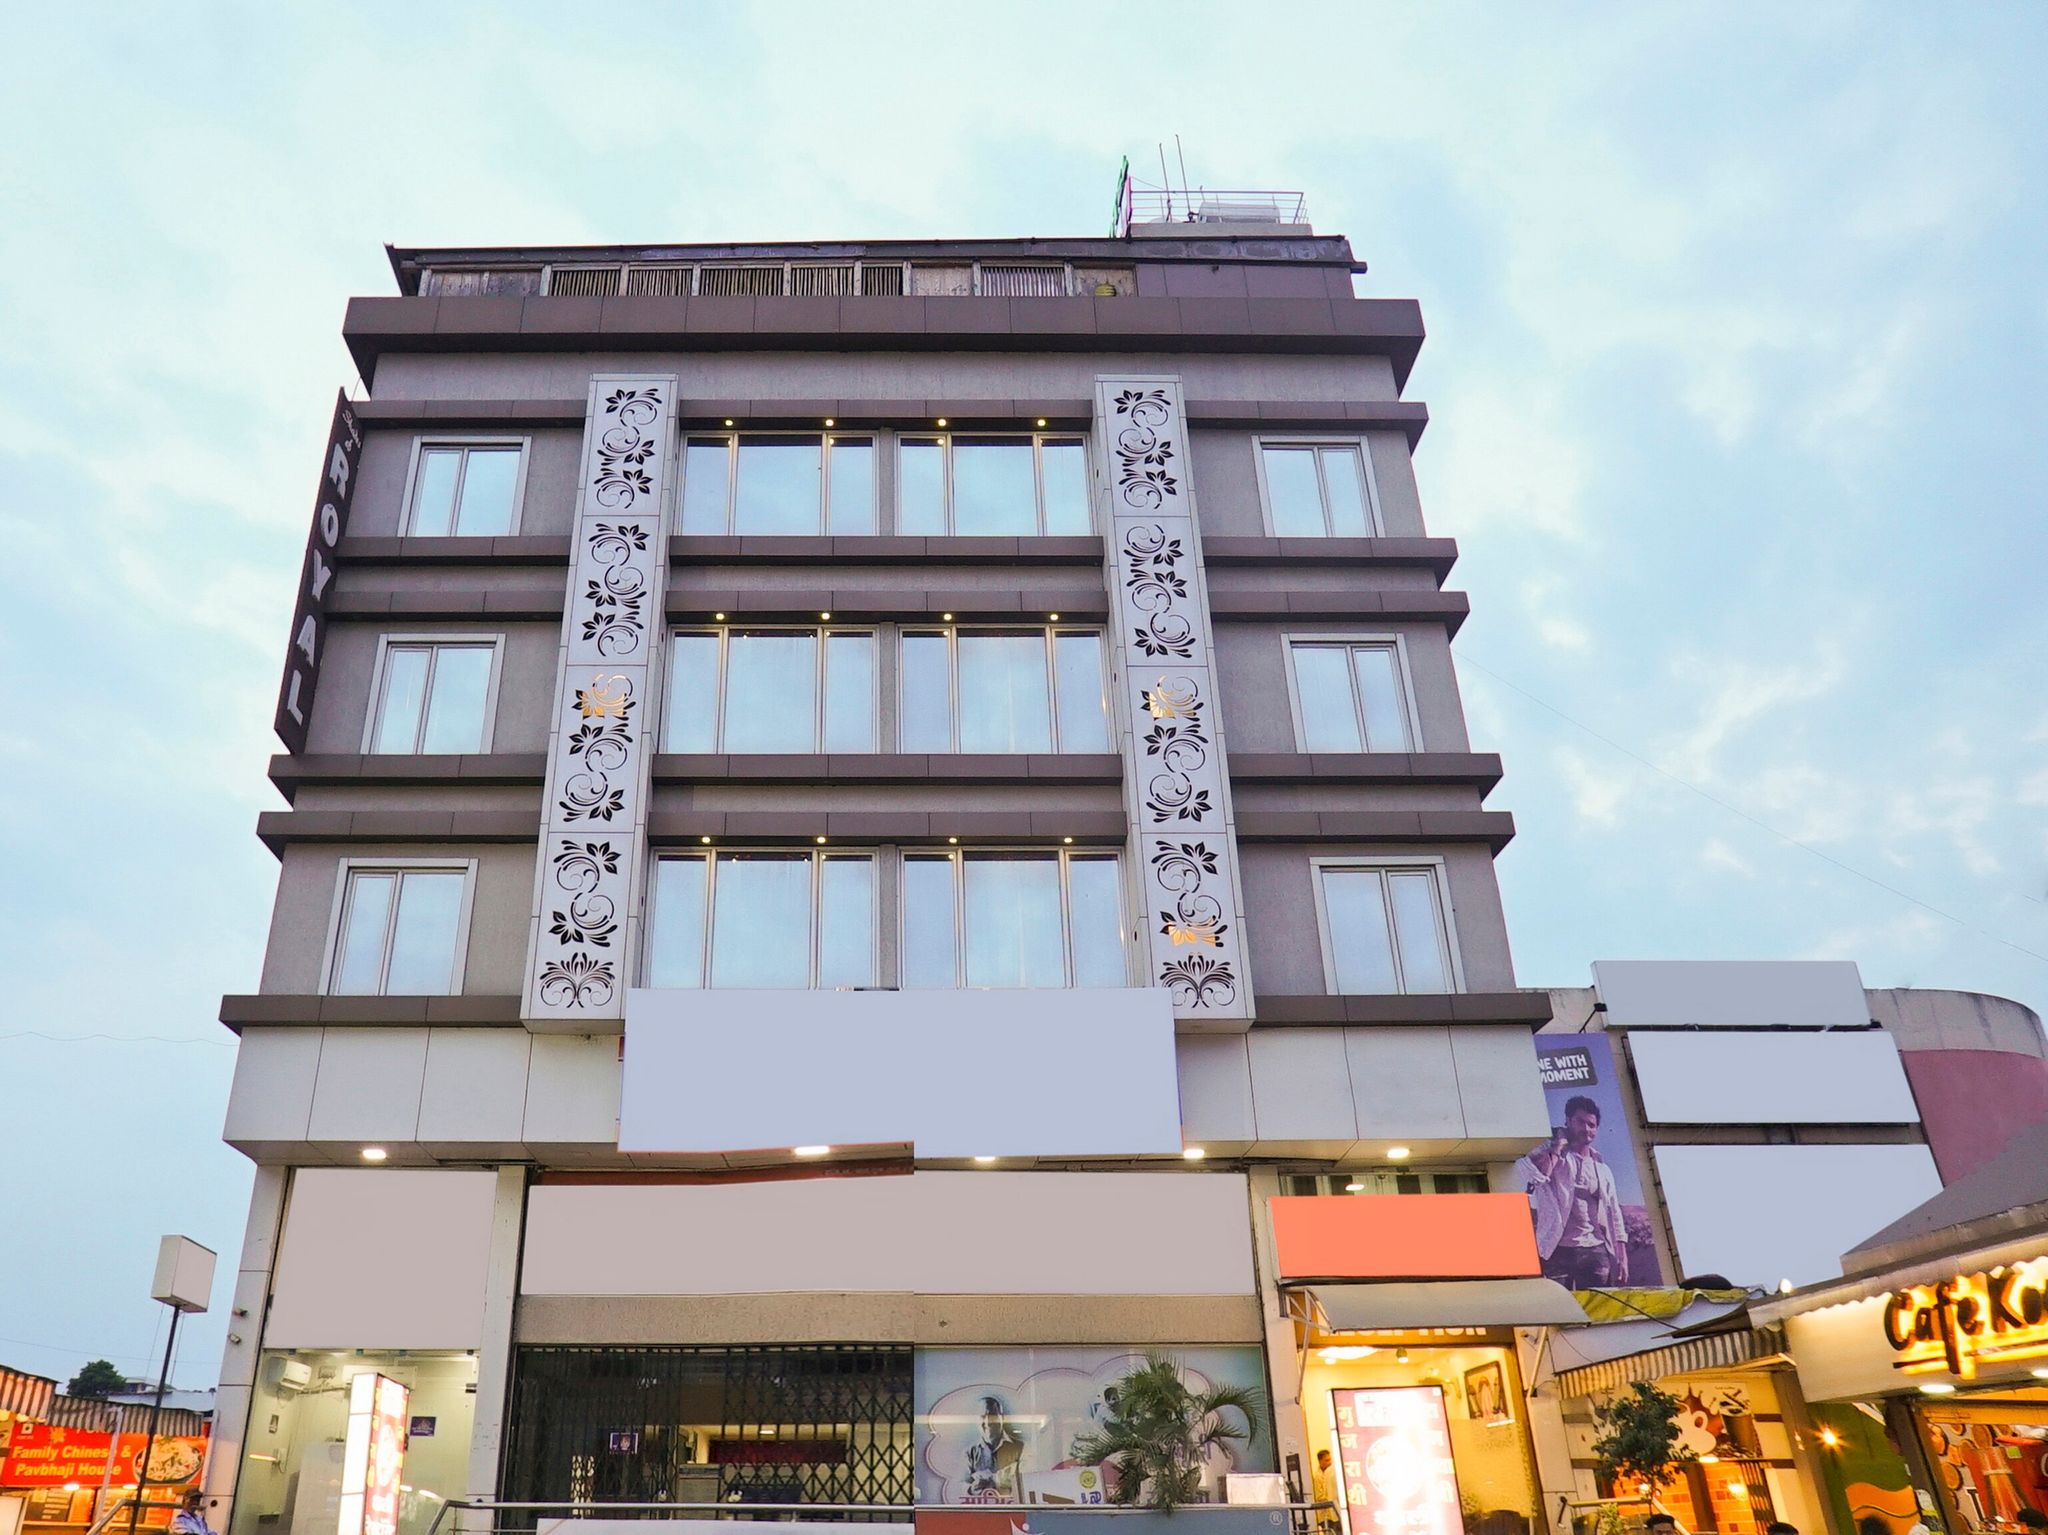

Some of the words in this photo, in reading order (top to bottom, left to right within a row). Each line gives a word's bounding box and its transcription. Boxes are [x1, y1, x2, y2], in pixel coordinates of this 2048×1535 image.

[287, 442, 350, 727] ROYAL
[1553, 1054, 1587, 1069] WITH
[12, 1445, 59, 1462] Family
[61, 1445, 116, 1459] Chines
[121, 1445, 131, 1458] &
[15, 1462, 75, 1479] Pavbhaji
[77, 1462, 122, 1476] Houe
